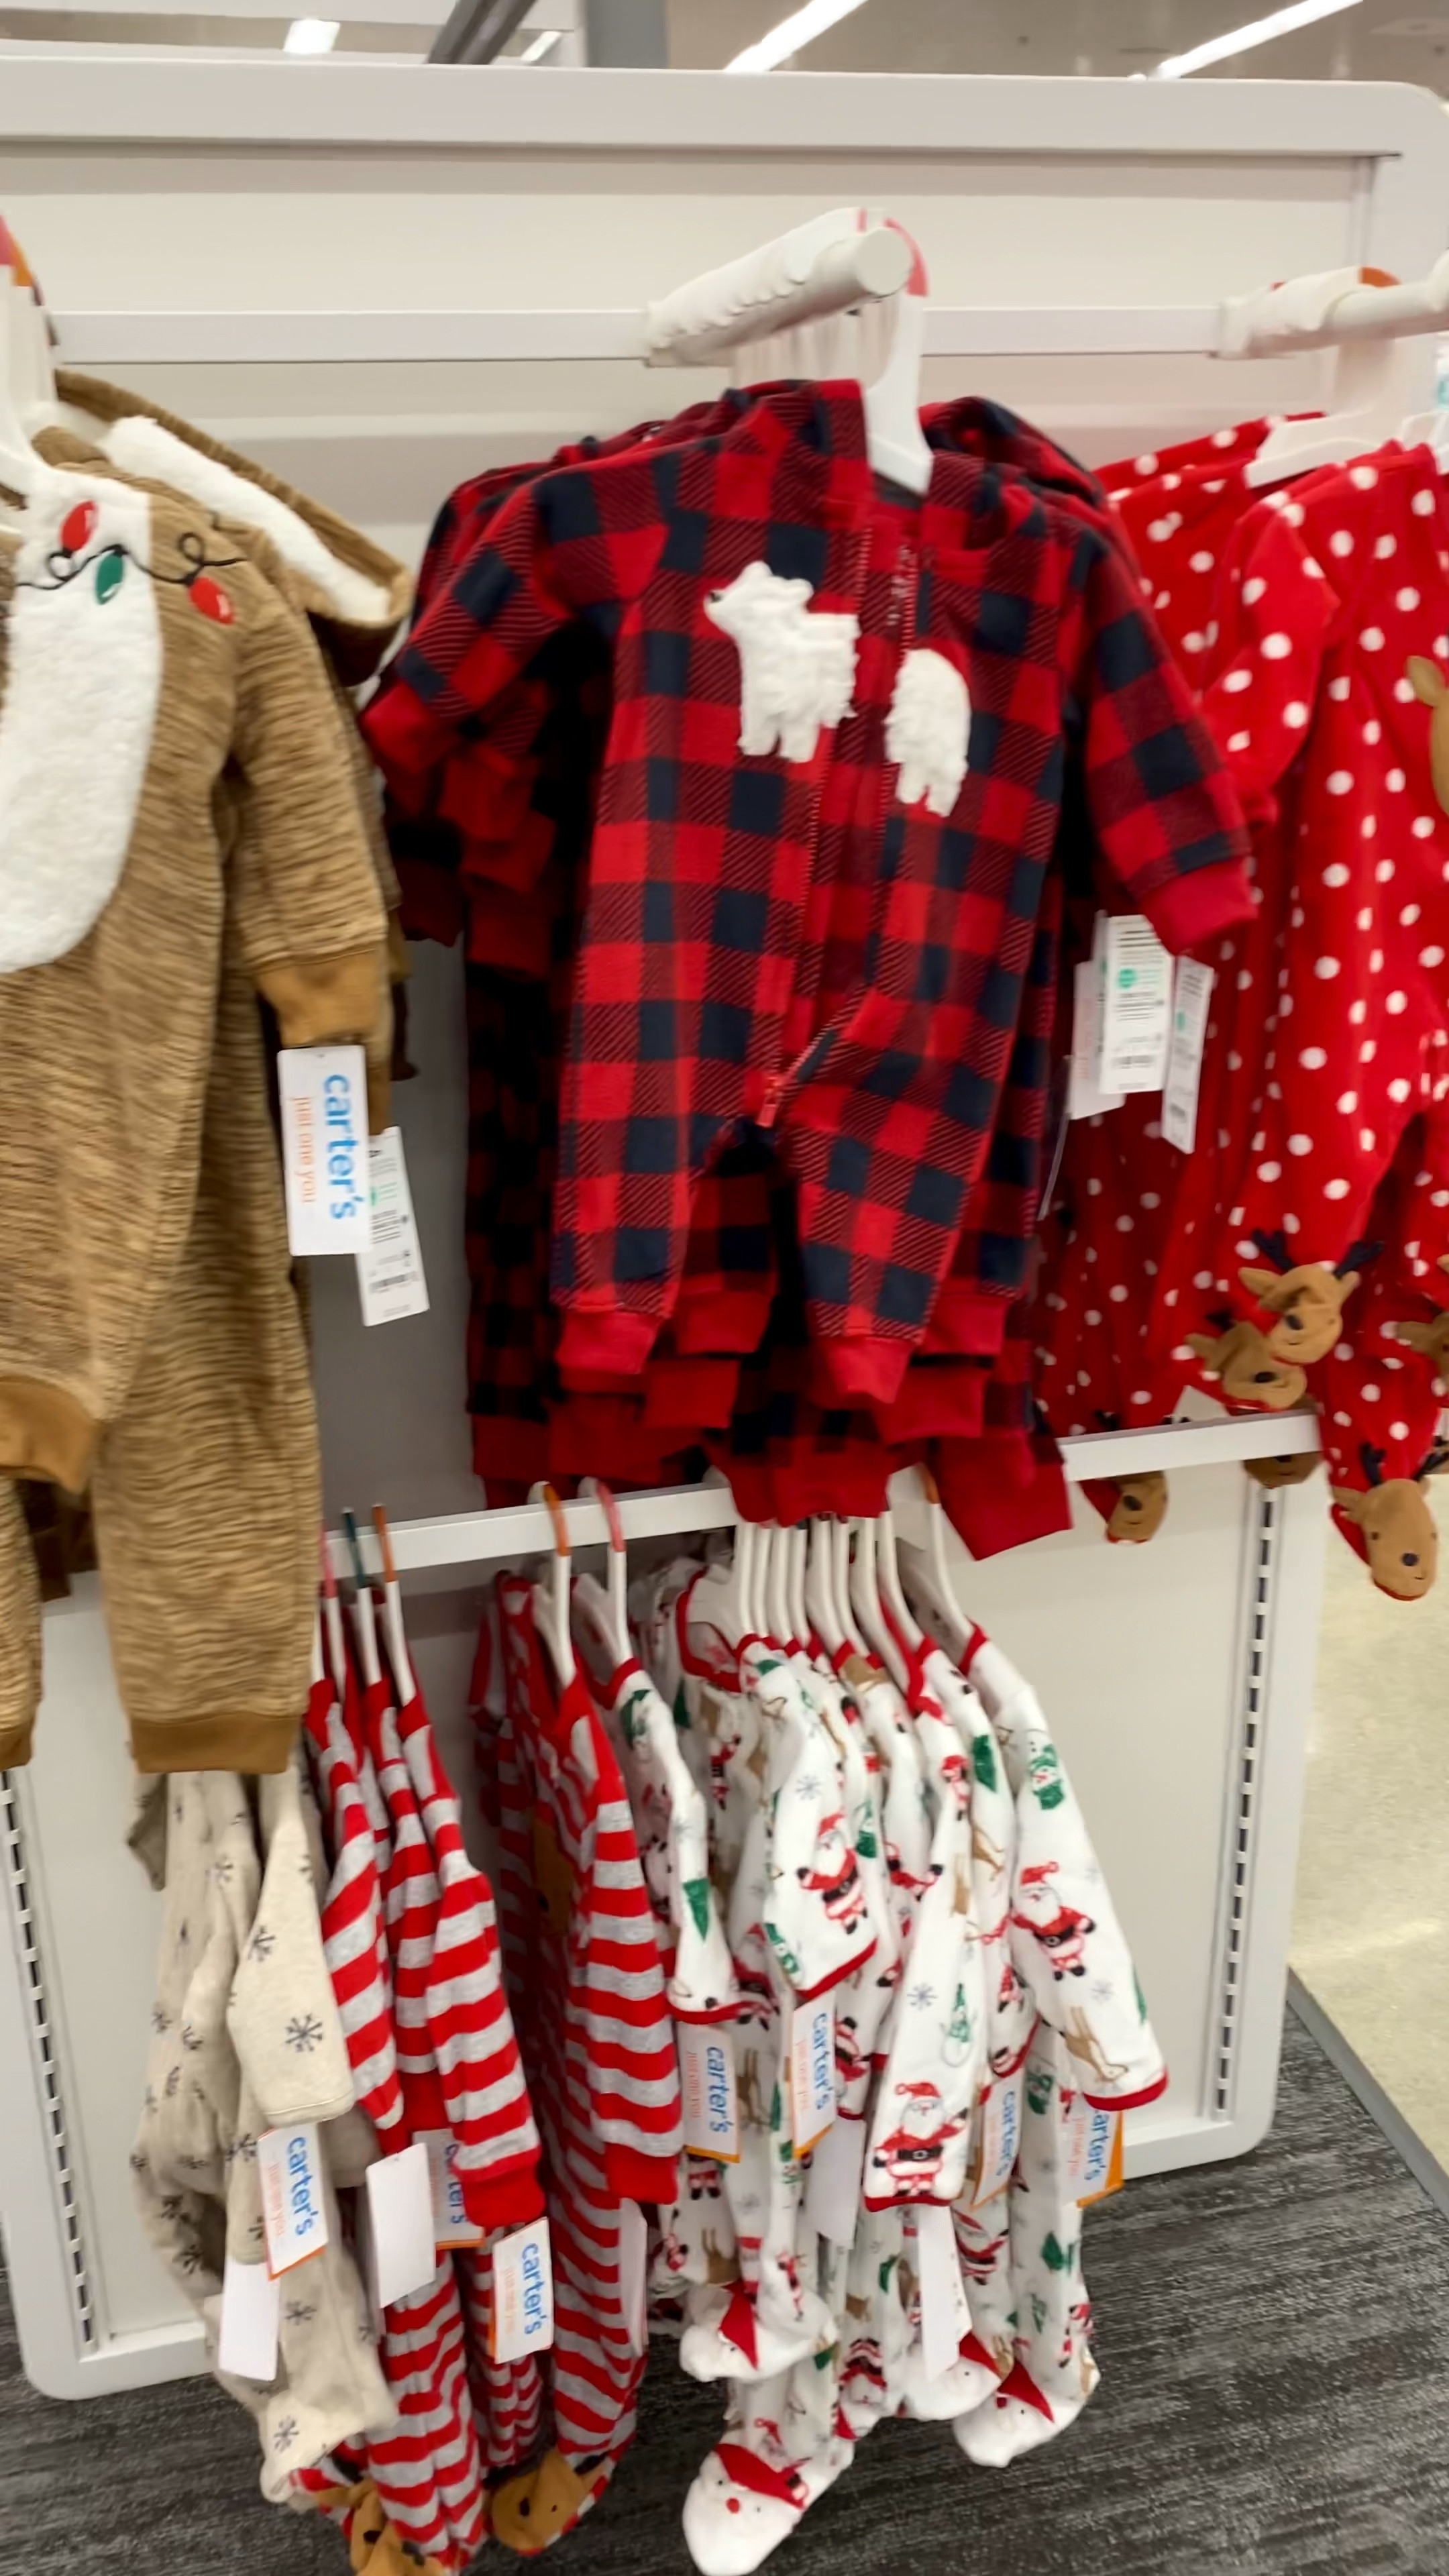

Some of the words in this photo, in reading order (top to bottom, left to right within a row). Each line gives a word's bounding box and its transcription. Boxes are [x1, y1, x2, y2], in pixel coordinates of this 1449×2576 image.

[323, 1074, 365, 1220] carter's
[706, 2046, 735, 2133] carter's
[812, 2012, 833, 2110] carter's
[286, 2137, 319, 2237] carter's
[1084, 2110, 1110, 2181] arter's
[522, 2243, 547, 2334] carter's
